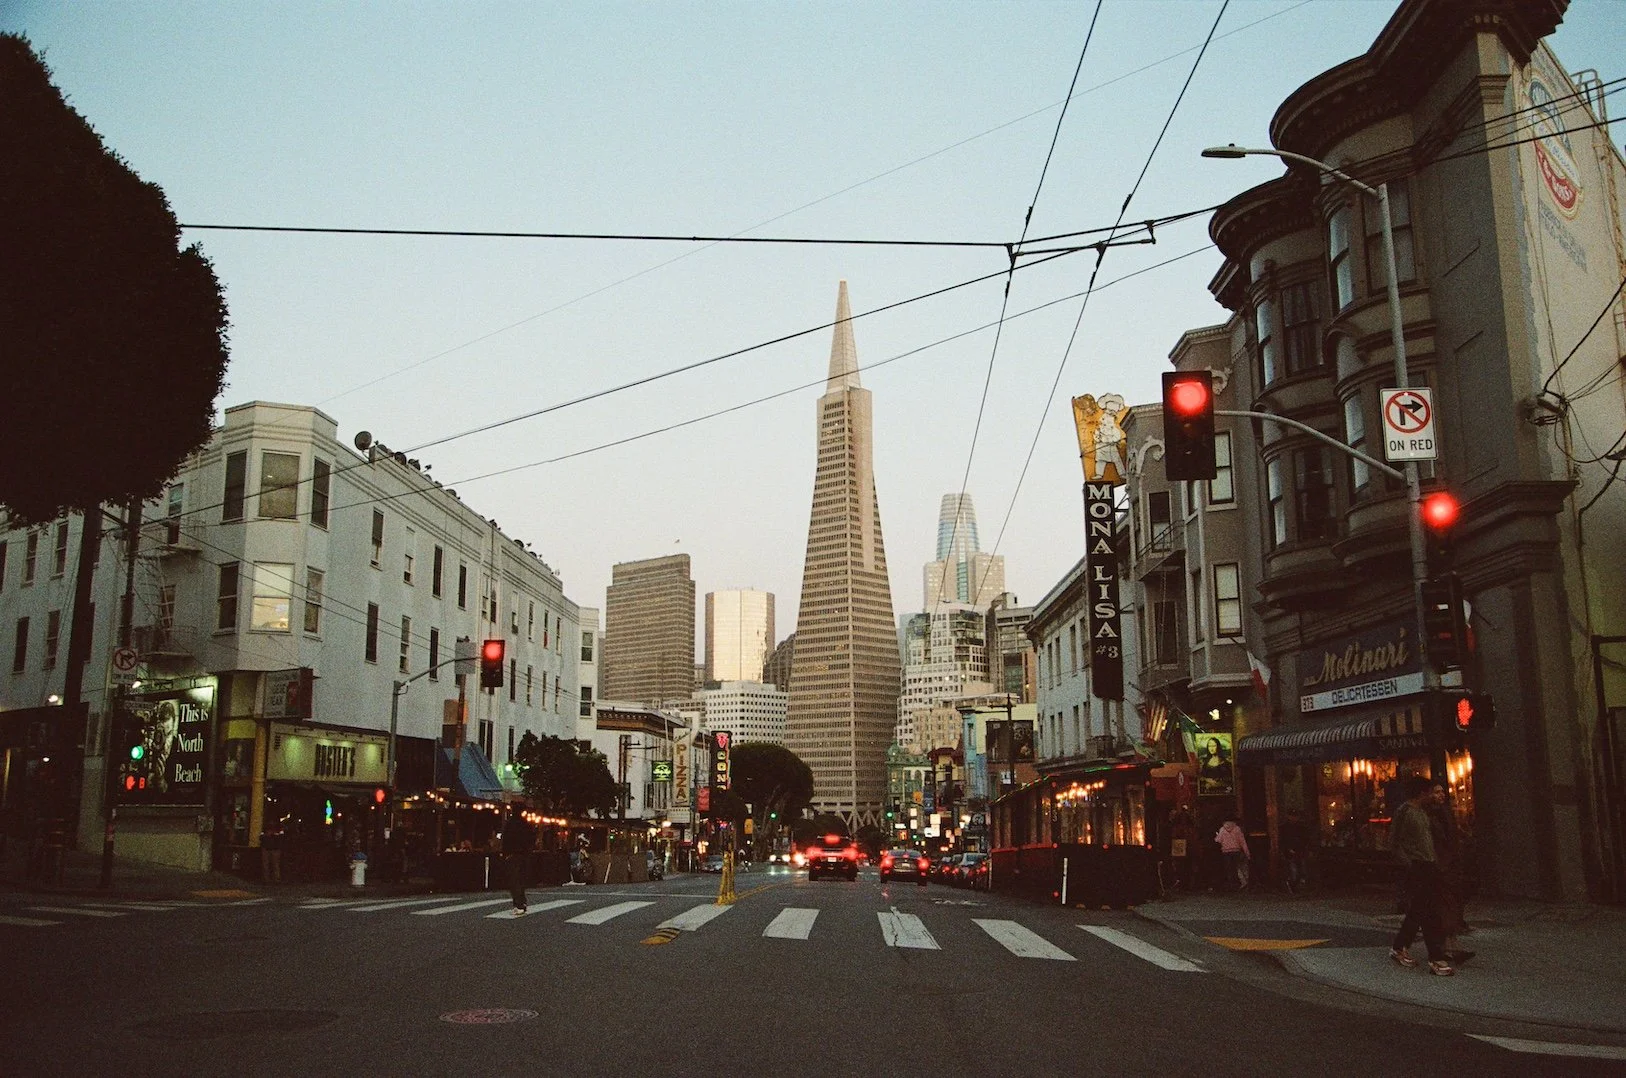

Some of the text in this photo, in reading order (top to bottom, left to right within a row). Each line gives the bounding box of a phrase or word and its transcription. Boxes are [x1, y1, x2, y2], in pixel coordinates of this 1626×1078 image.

[1389, 438, 1433, 452] ON RED
[1087, 484, 1117, 638] MONA LISA
[1096, 645, 1119, 659] #3
[1305, 628, 1408, 686] Molinari
[1331, 679, 1398, 705] DELICATESSEN
[180, 703, 209, 723] This is
[177, 732, 204, 753] North
[174, 762, 202, 783] Beach
[675, 744, 687, 799] PIZZA
